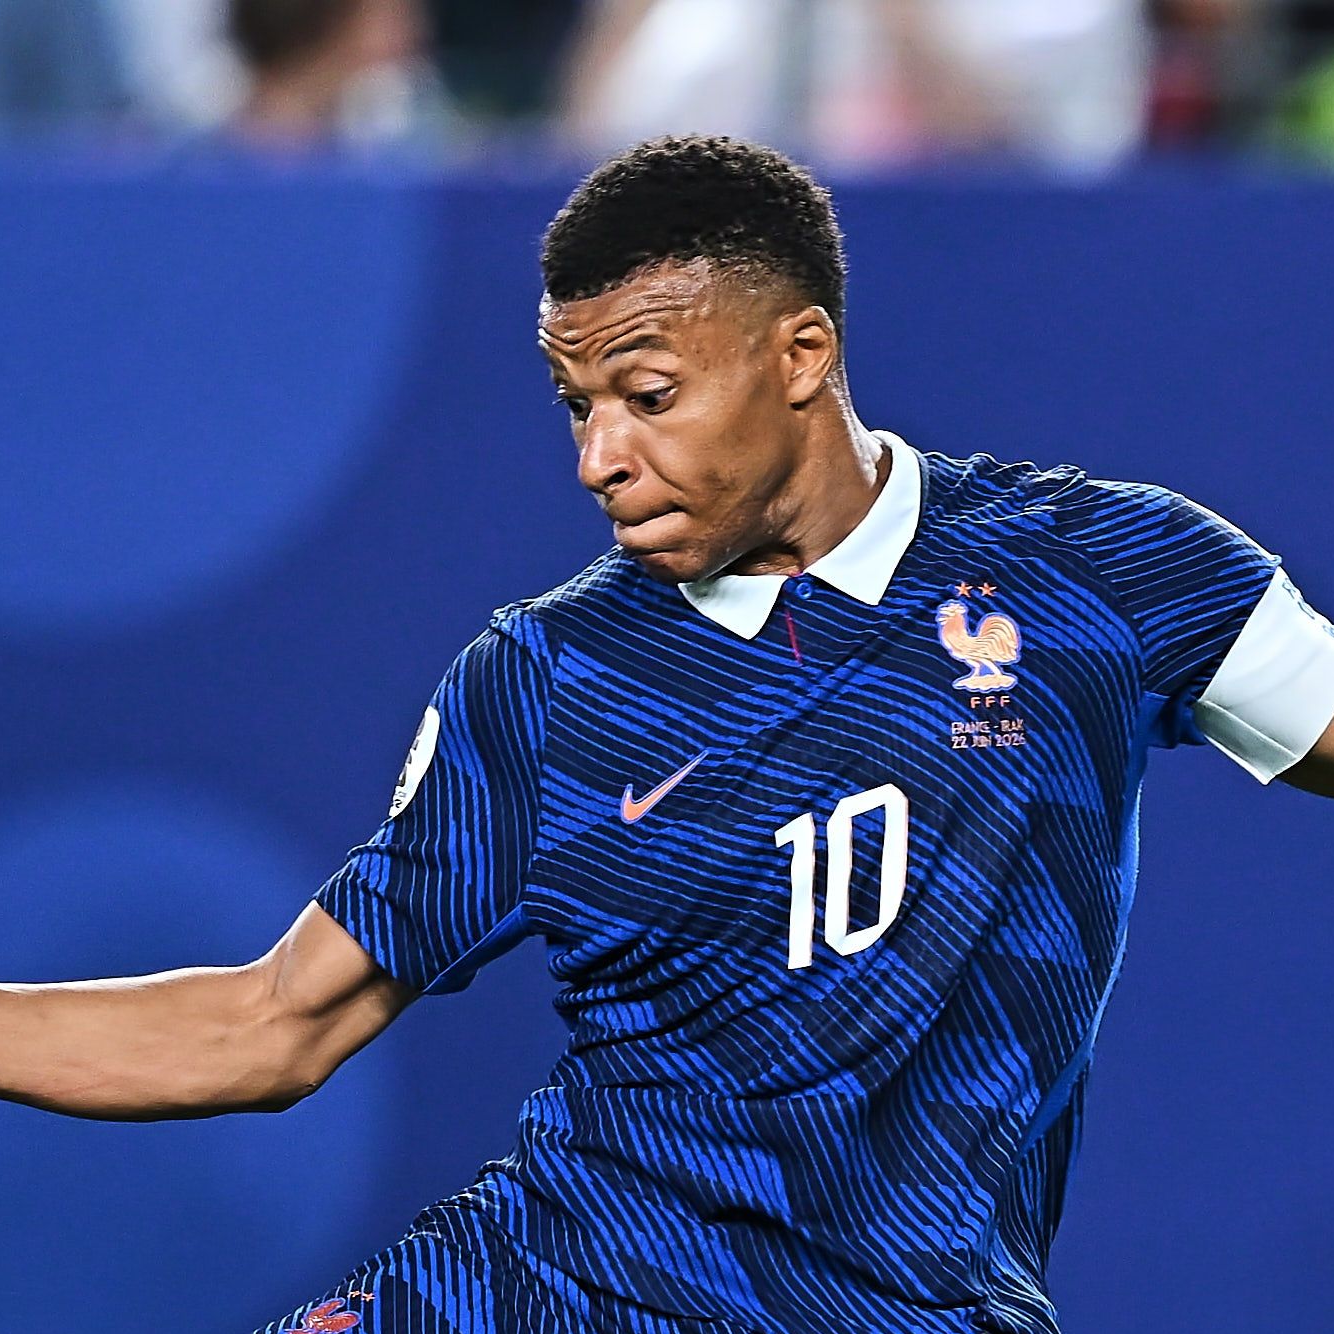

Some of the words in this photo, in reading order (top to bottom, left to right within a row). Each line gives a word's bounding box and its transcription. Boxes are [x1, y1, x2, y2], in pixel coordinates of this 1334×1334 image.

[951, 735, 969, 749] 22
[994, 733, 1026, 747] 2026
[774, 782, 909, 970] 10
